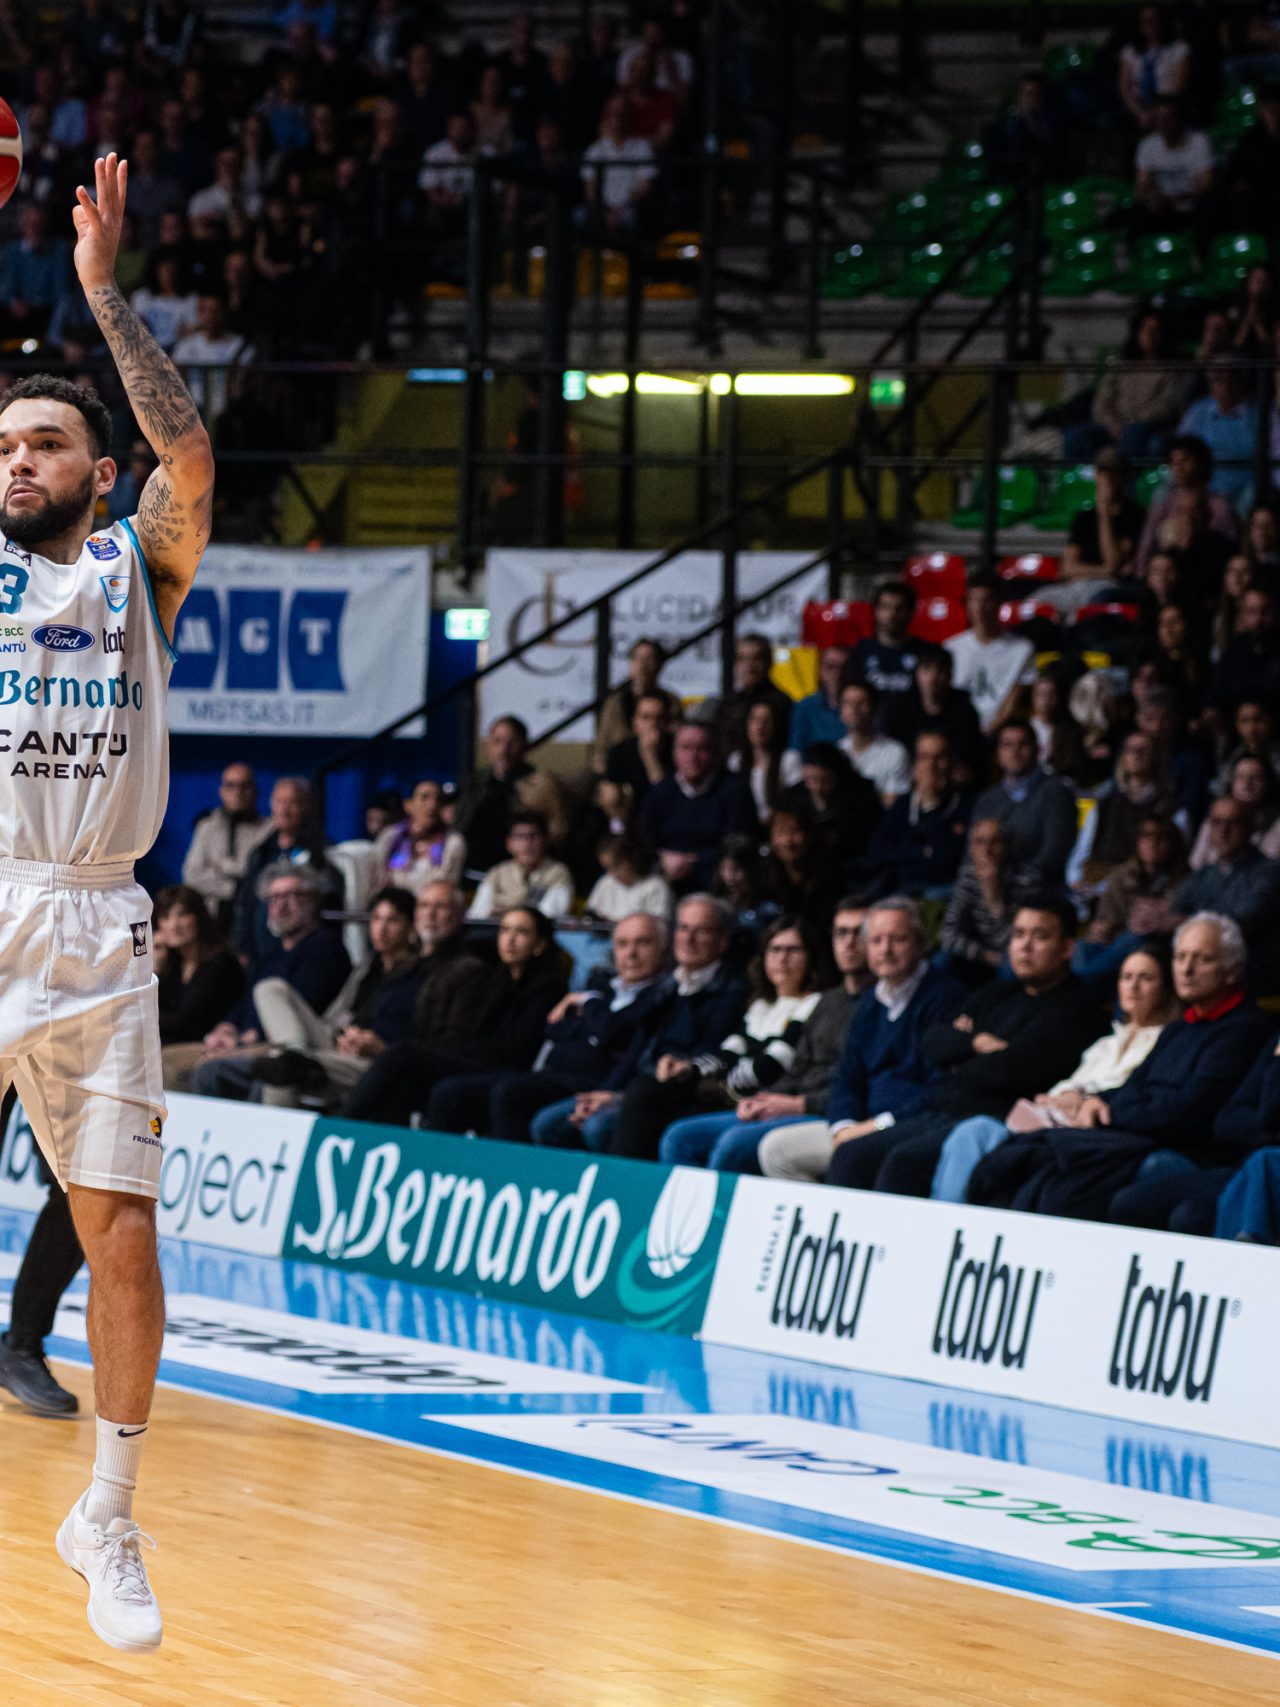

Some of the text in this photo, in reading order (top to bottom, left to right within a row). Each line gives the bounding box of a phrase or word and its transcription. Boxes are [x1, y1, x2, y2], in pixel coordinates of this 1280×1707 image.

[4, 627, 24, 638] BCC
[44, 627, 81, 648] Ford
[10, 761, 107, 780] ARENA
[132, 1135, 160, 1148] FRIGERIO
[161, 1129, 288, 1233] oject
[293, 1136, 620, 1299] S.Bernardo
[771, 1206, 875, 1340] tabu
[931, 1228, 1043, 1370] tabu
[1108, 1252, 1229, 1404] tabu
